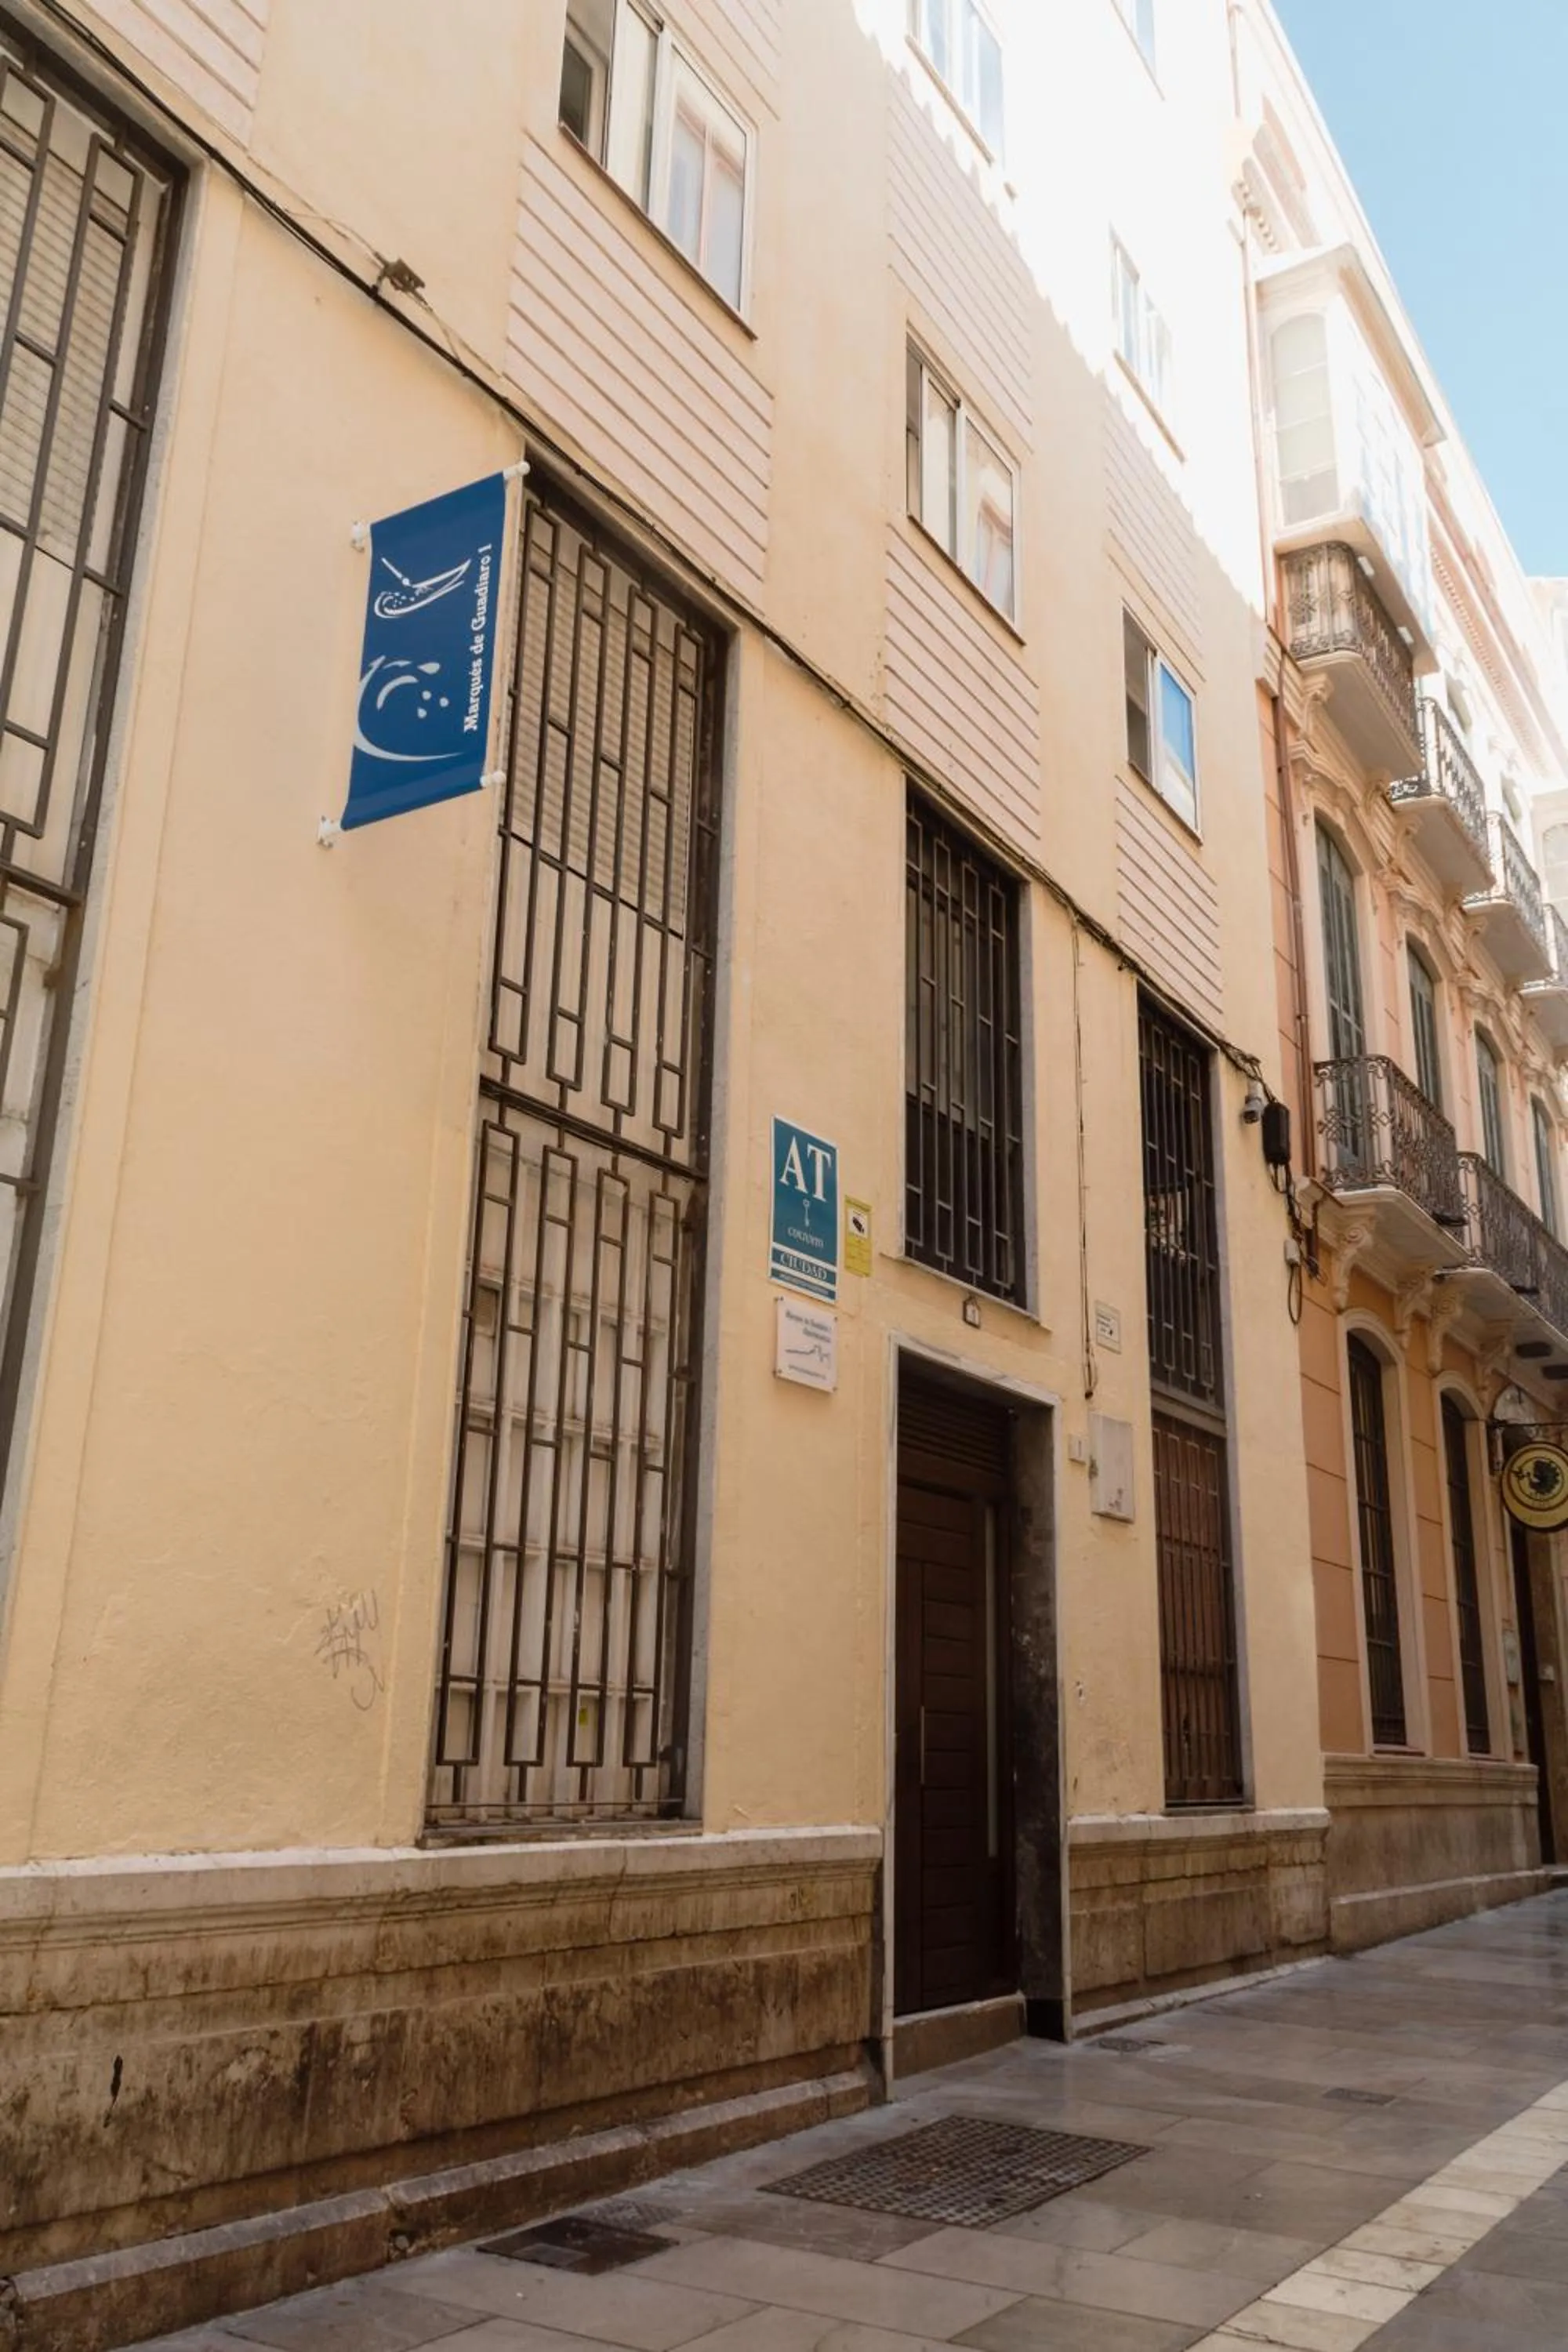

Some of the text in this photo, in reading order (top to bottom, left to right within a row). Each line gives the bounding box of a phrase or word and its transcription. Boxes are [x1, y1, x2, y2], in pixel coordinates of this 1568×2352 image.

[471, 554, 492, 631] Guadiaro
[470, 633, 485, 655] de
[463, 658, 484, 732] Marqués
[779, 1134, 832, 1203] AT
